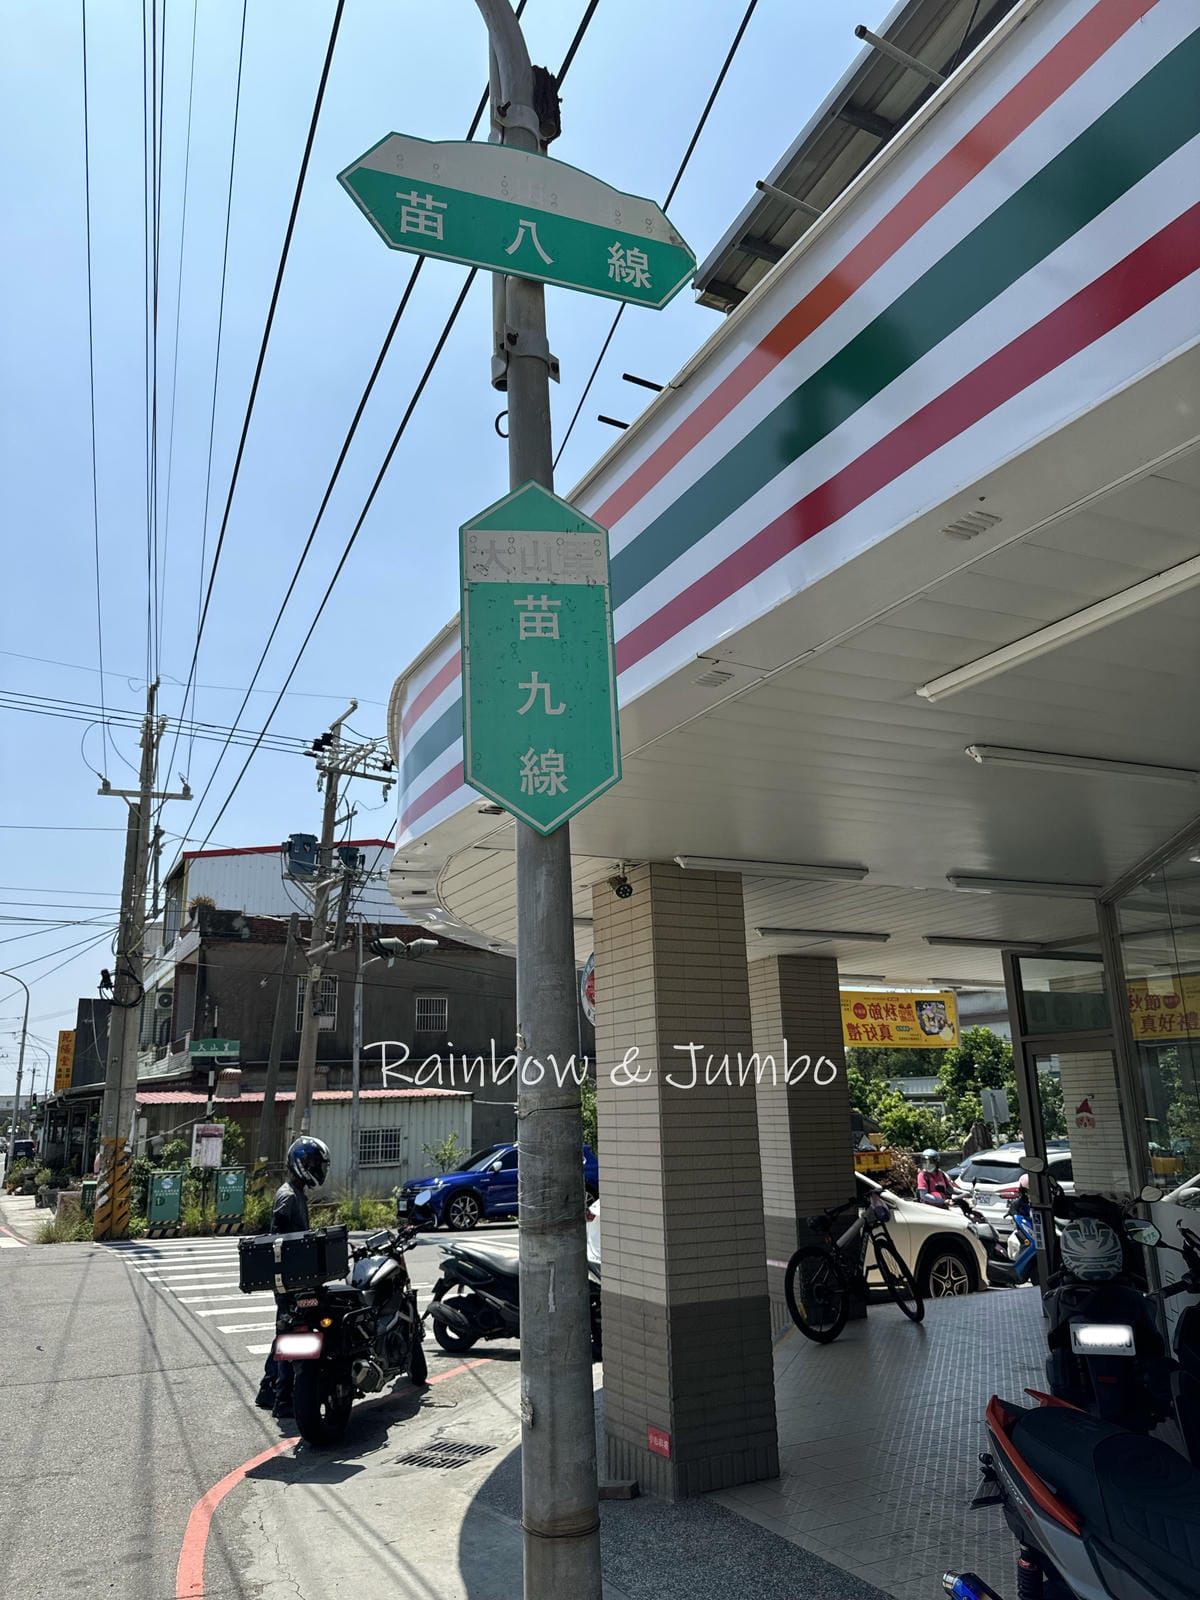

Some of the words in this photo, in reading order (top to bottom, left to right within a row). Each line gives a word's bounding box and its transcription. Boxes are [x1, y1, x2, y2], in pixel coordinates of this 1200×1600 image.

[395, 190, 652, 289] 苗八線
[514, 594, 569, 796] 苗九線
